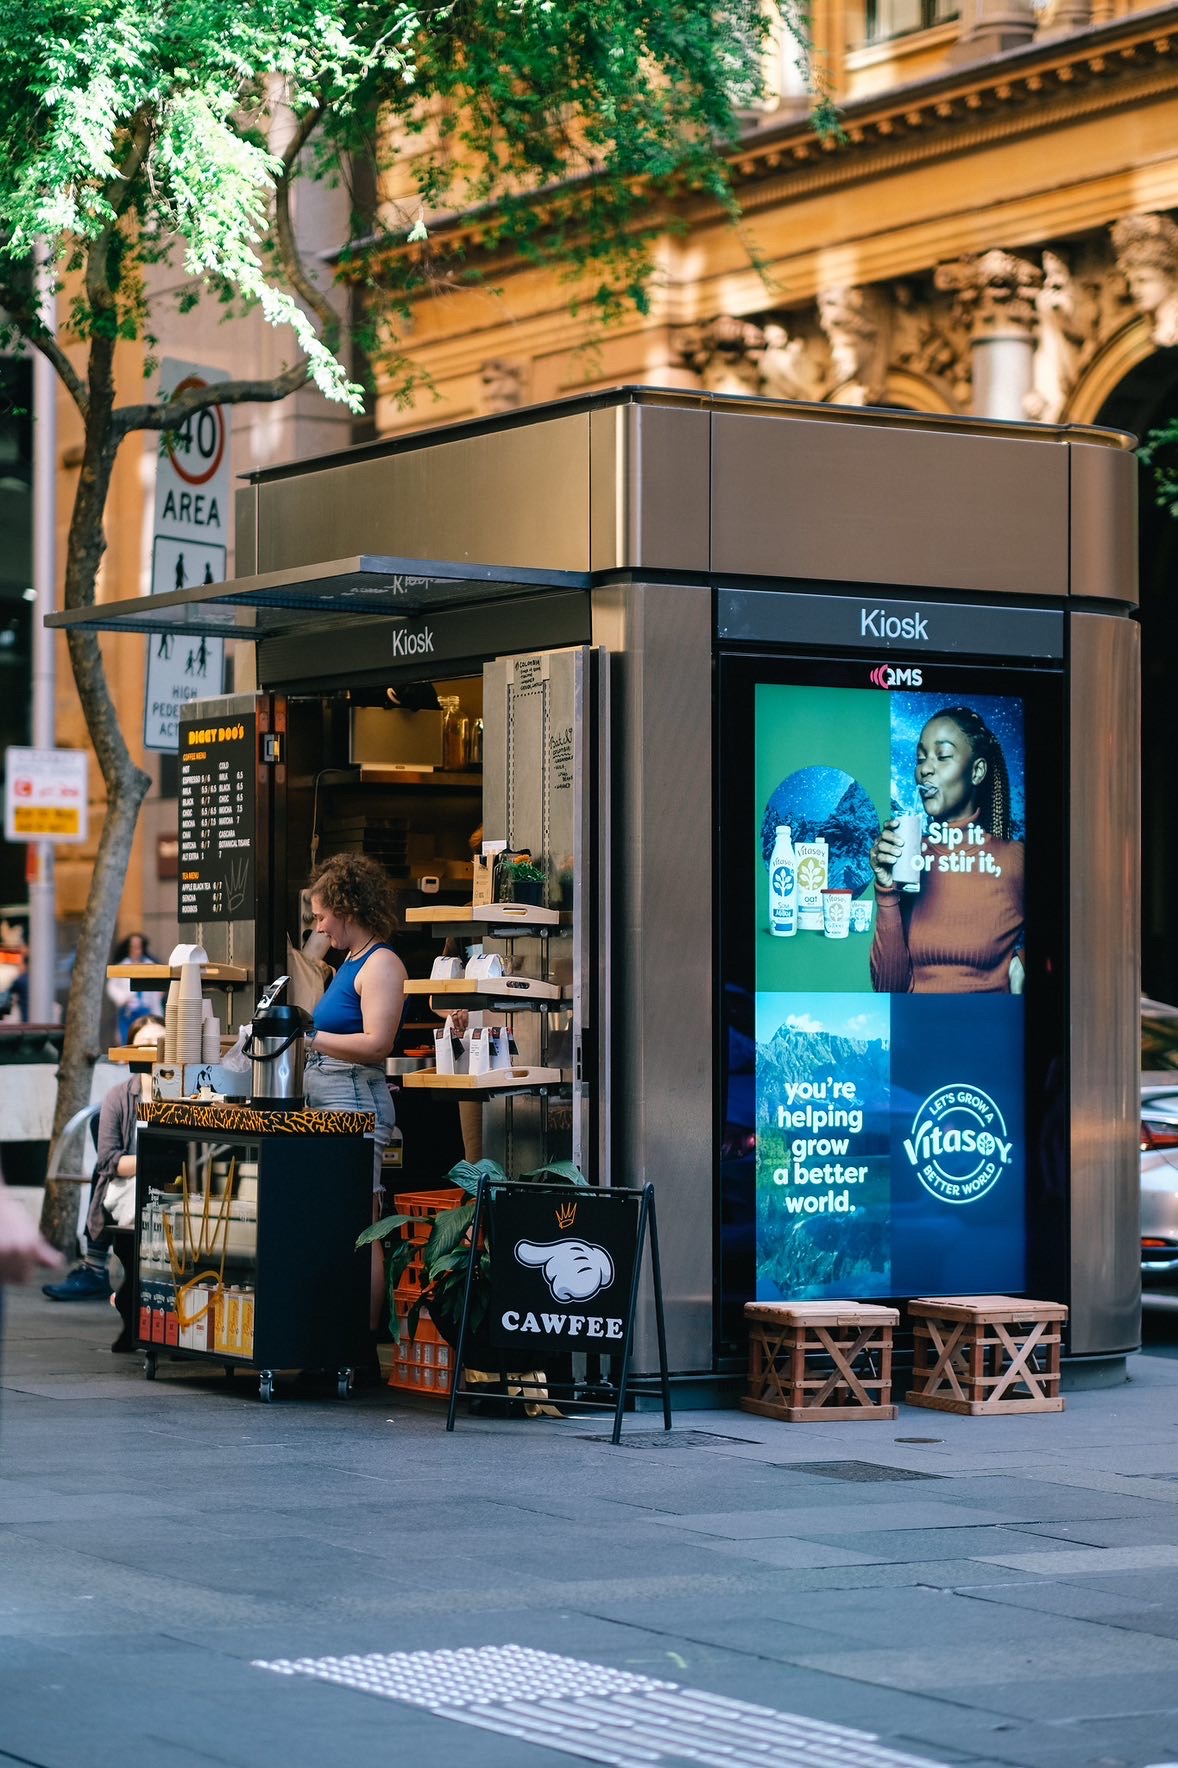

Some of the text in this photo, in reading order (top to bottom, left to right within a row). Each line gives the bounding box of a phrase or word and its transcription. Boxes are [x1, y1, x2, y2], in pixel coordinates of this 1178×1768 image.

[162, 489, 221, 527] AREA
[861, 608, 929, 641] Kiosk
[392, 627, 434, 656] Kiosk
[878, 664, 923, 689] QMS
[172, 684, 198, 699] HIGH
[153, 702, 179, 717] PEDE
[182, 765, 190, 774] HOT
[219, 761, 229, 770] COLD
[182, 775, 200, 785] ESPRESSO
[219, 783, 231, 793] BLACK
[182, 798, 194, 807] BLACK
[219, 806, 233, 814] MOCHA
[182, 819, 196, 828] MOCHA
[928, 821, 985, 850] Sip it
[911, 850, 1002, 878] or stir it,
[784, 1077, 856, 1105] you're
[777, 1105, 863, 1133] helping
[928, 1091, 994, 1124] LET'S GROW A
[791, 1138, 850, 1162] grow
[773, 1162, 868, 1185] a better
[923, 1162, 995, 1196] BETTER WORLD
[785, 1190, 856, 1214] world.
[501, 1310, 623, 1339] CAWFEE
